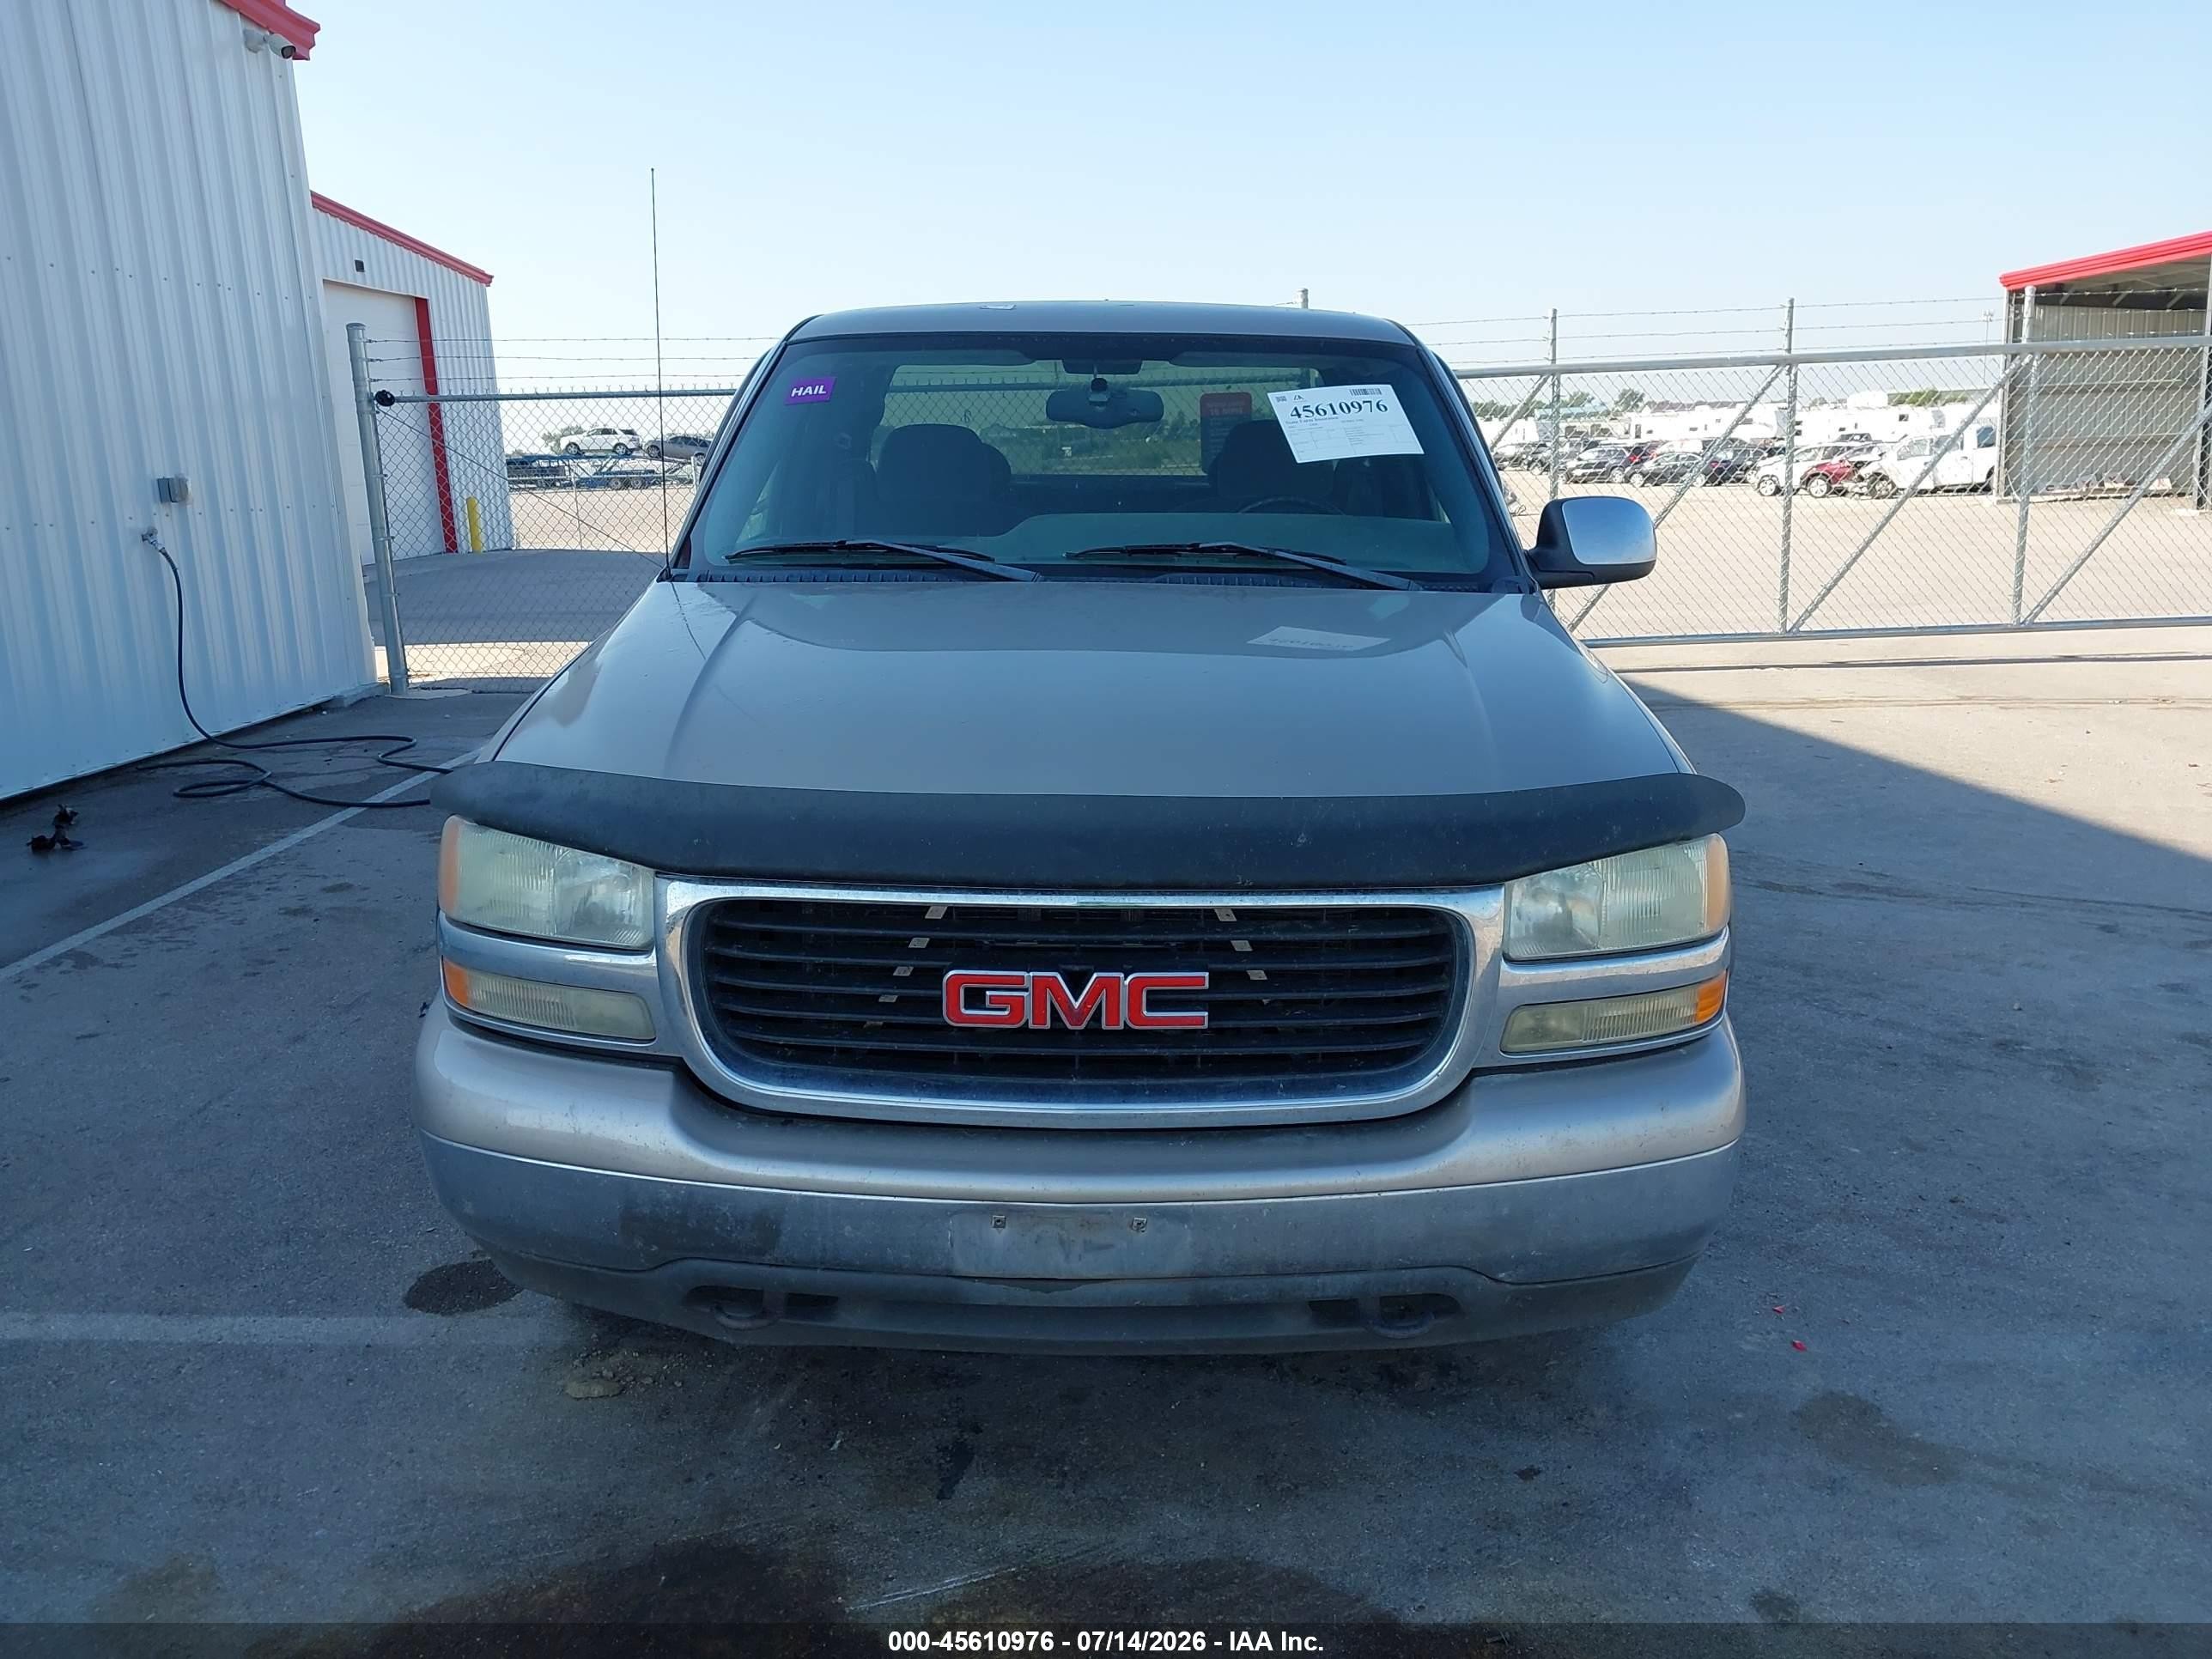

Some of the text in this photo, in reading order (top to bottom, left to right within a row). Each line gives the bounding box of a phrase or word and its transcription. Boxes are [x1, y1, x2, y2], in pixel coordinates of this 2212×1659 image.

[791, 385, 826, 398] HAIL
[1290, 399, 1388, 418] 45610976
[942, 969, 1209, 1030] GMC
